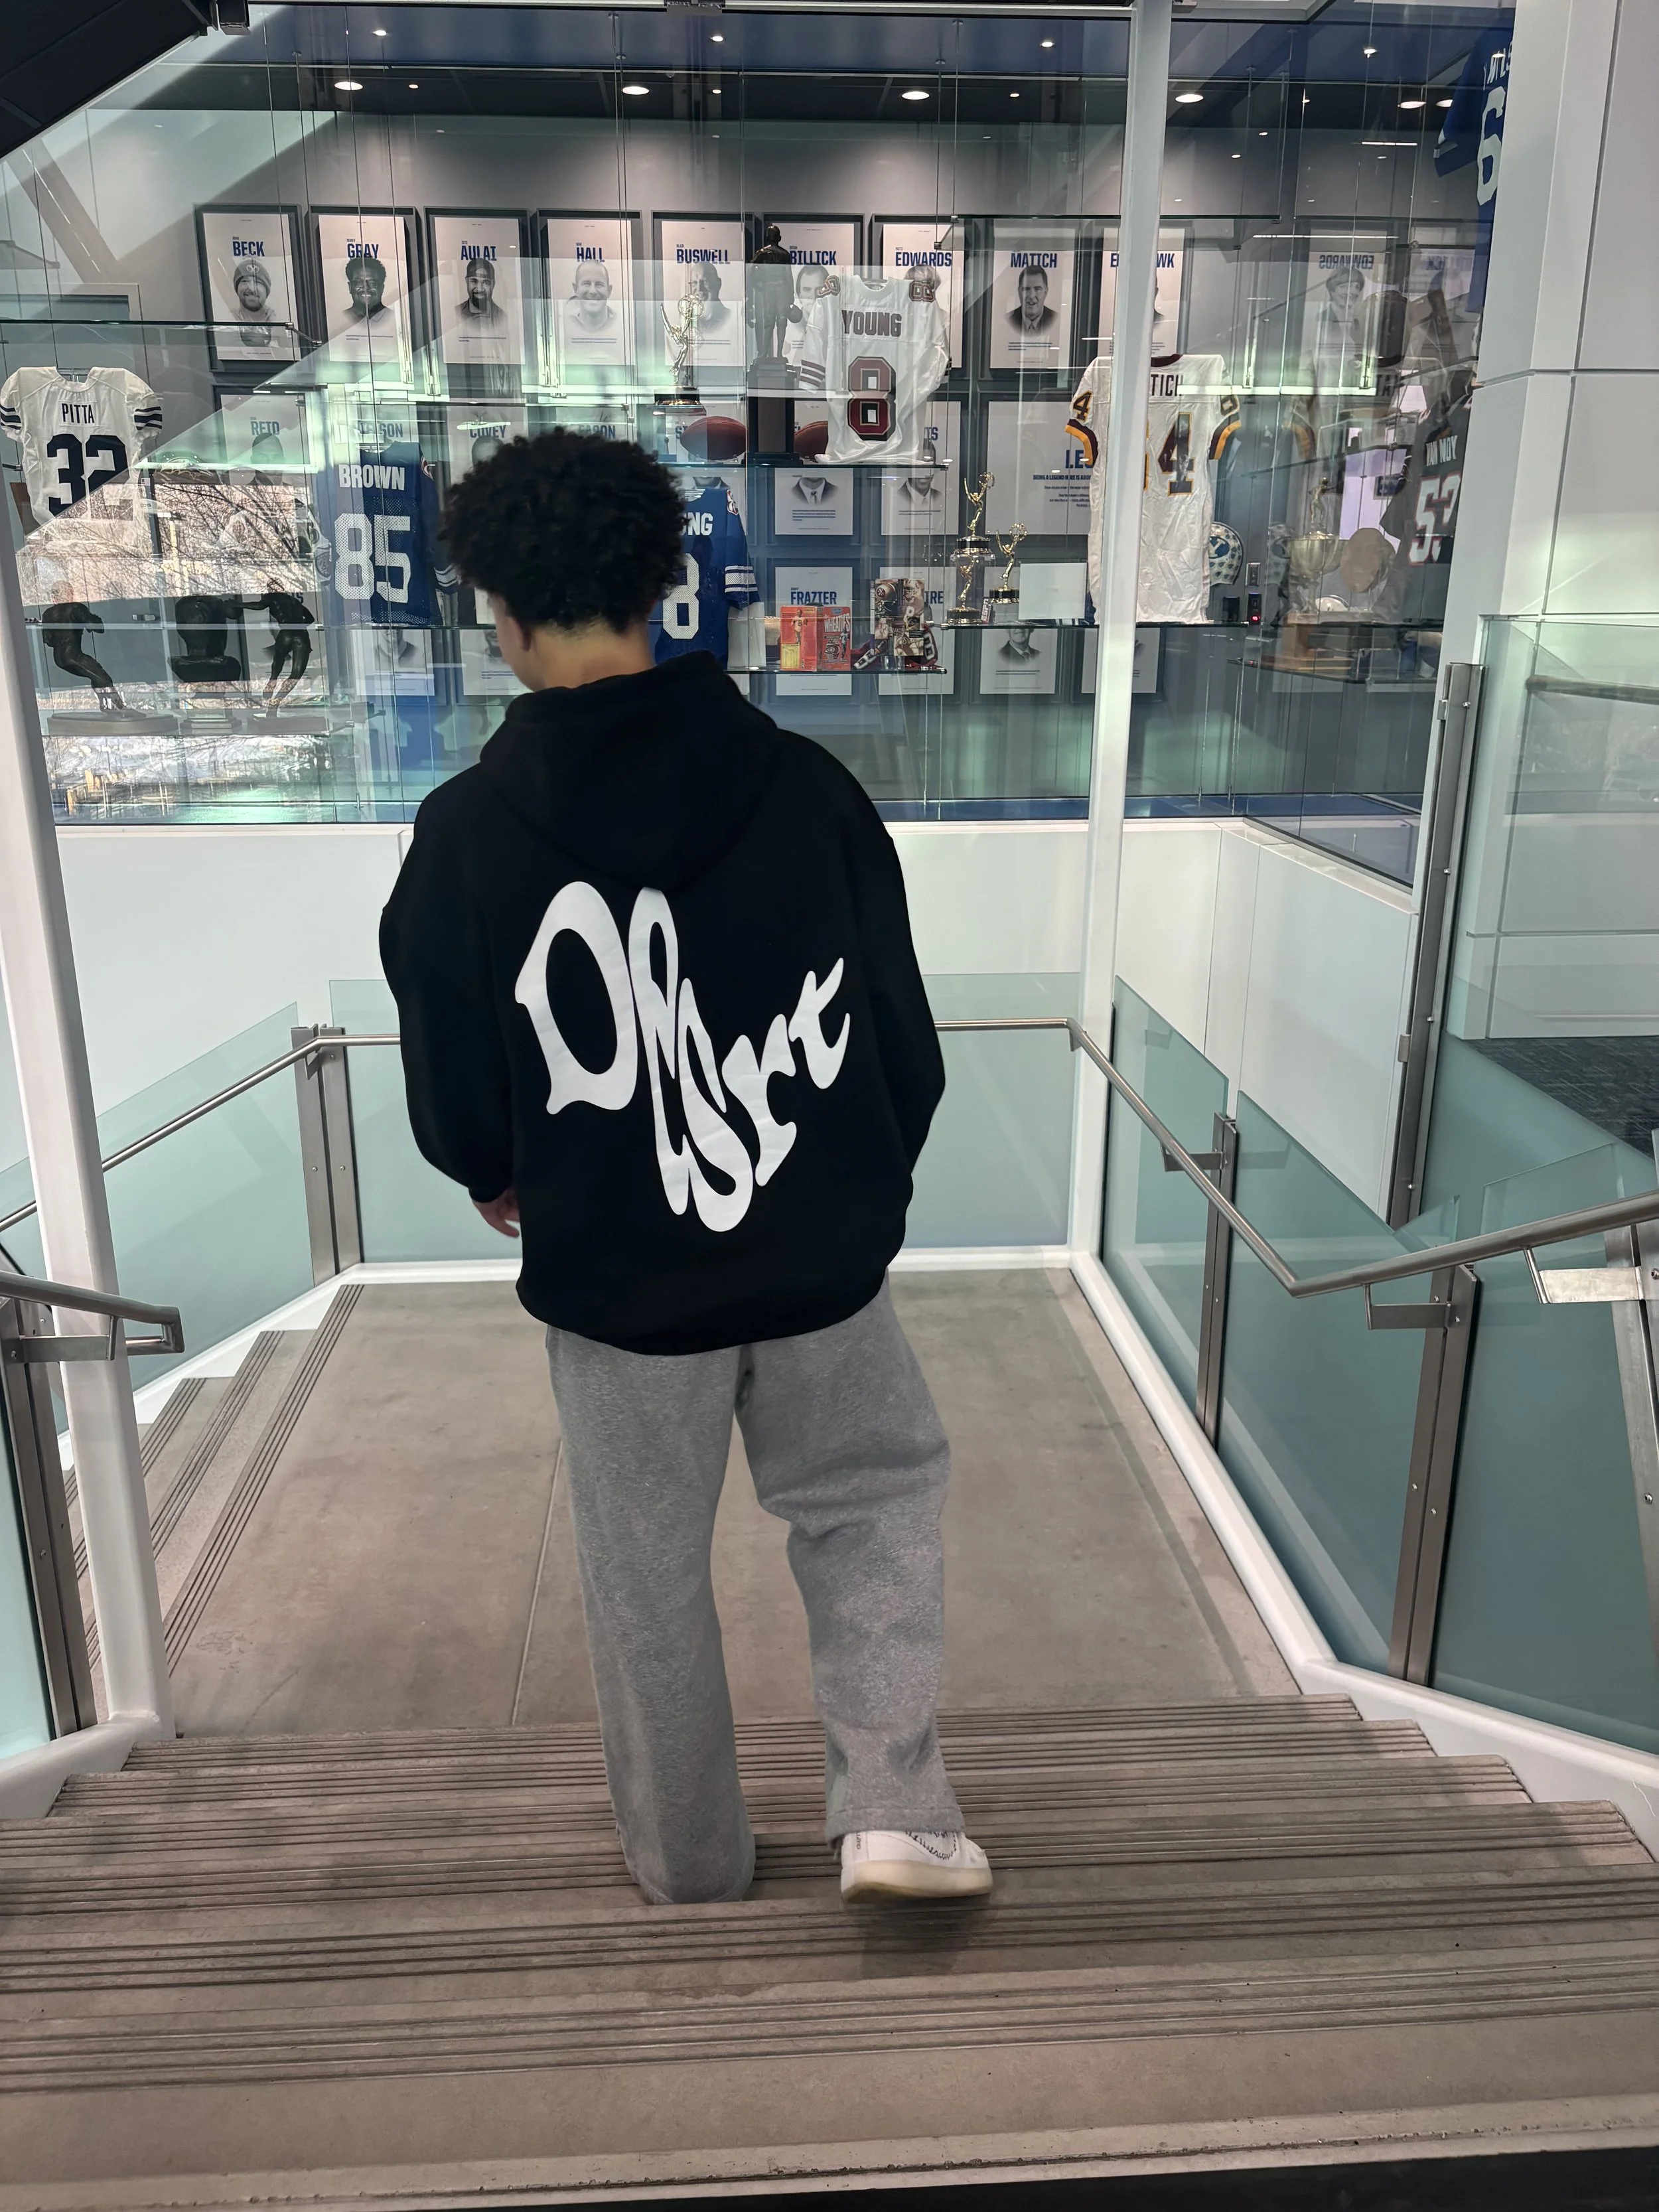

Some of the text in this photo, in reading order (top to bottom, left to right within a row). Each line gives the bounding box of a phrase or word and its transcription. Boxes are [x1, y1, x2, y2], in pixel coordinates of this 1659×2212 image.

[232, 241, 265, 257] BECK
[346, 243, 380, 259] GRAY
[576, 247, 605, 263] HALL
[676, 249, 731, 265] BUSWELL
[789, 250, 837, 266] BILLICK
[895, 252, 952, 267] EDWARDS
[841, 309, 902, 338] YOUNG
[847, 355, 895, 441] 8
[61, 402, 94, 425] PITTA
[46, 433, 129, 522] 32
[338, 464, 405, 491] BROWN
[334, 513, 411, 603] 85
[790, 591, 837, 605] FRAZIER
[824, 613, 850, 632] WHEATIES
